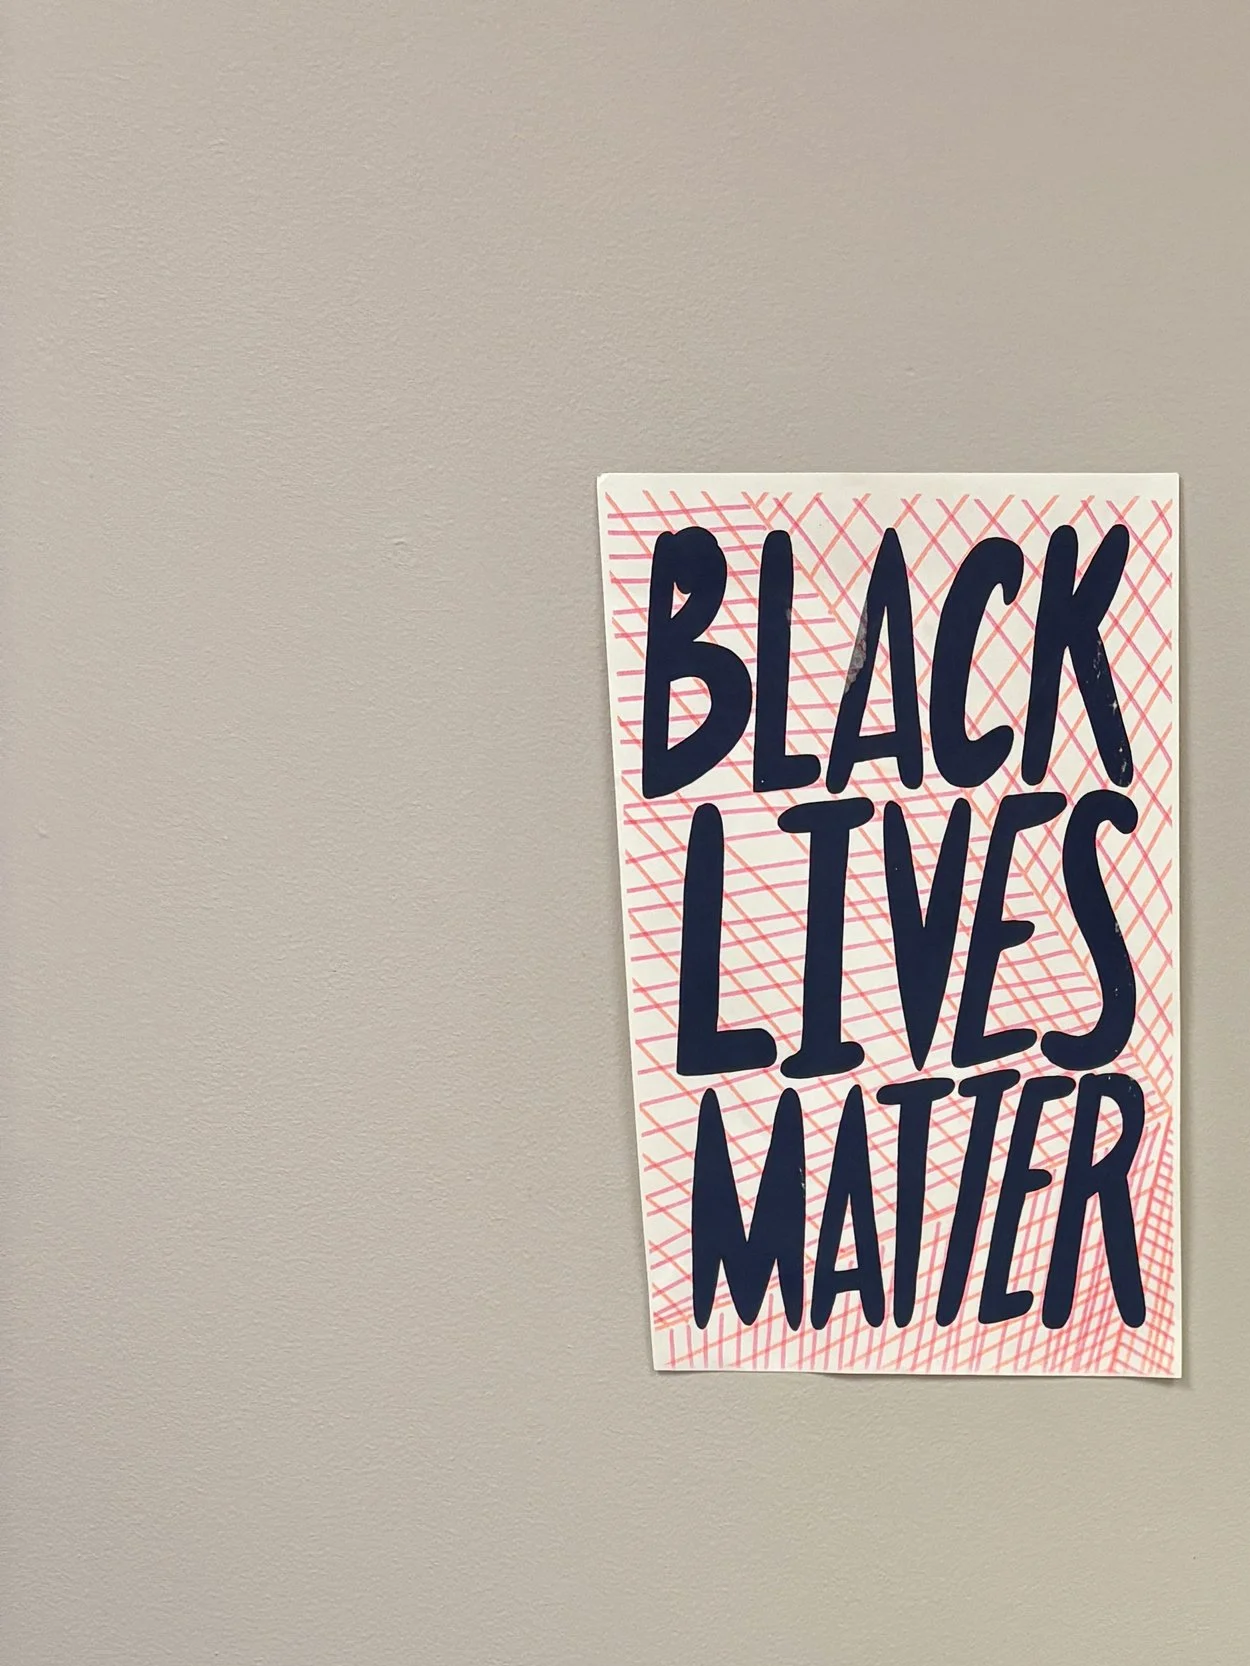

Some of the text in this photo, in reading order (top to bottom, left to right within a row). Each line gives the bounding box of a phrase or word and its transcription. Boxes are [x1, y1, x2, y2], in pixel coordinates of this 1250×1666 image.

[642, 524, 1133, 799] BLACK
[677, 789, 1139, 1079] LIVES
[691, 1070, 1145, 1330] MATTER
